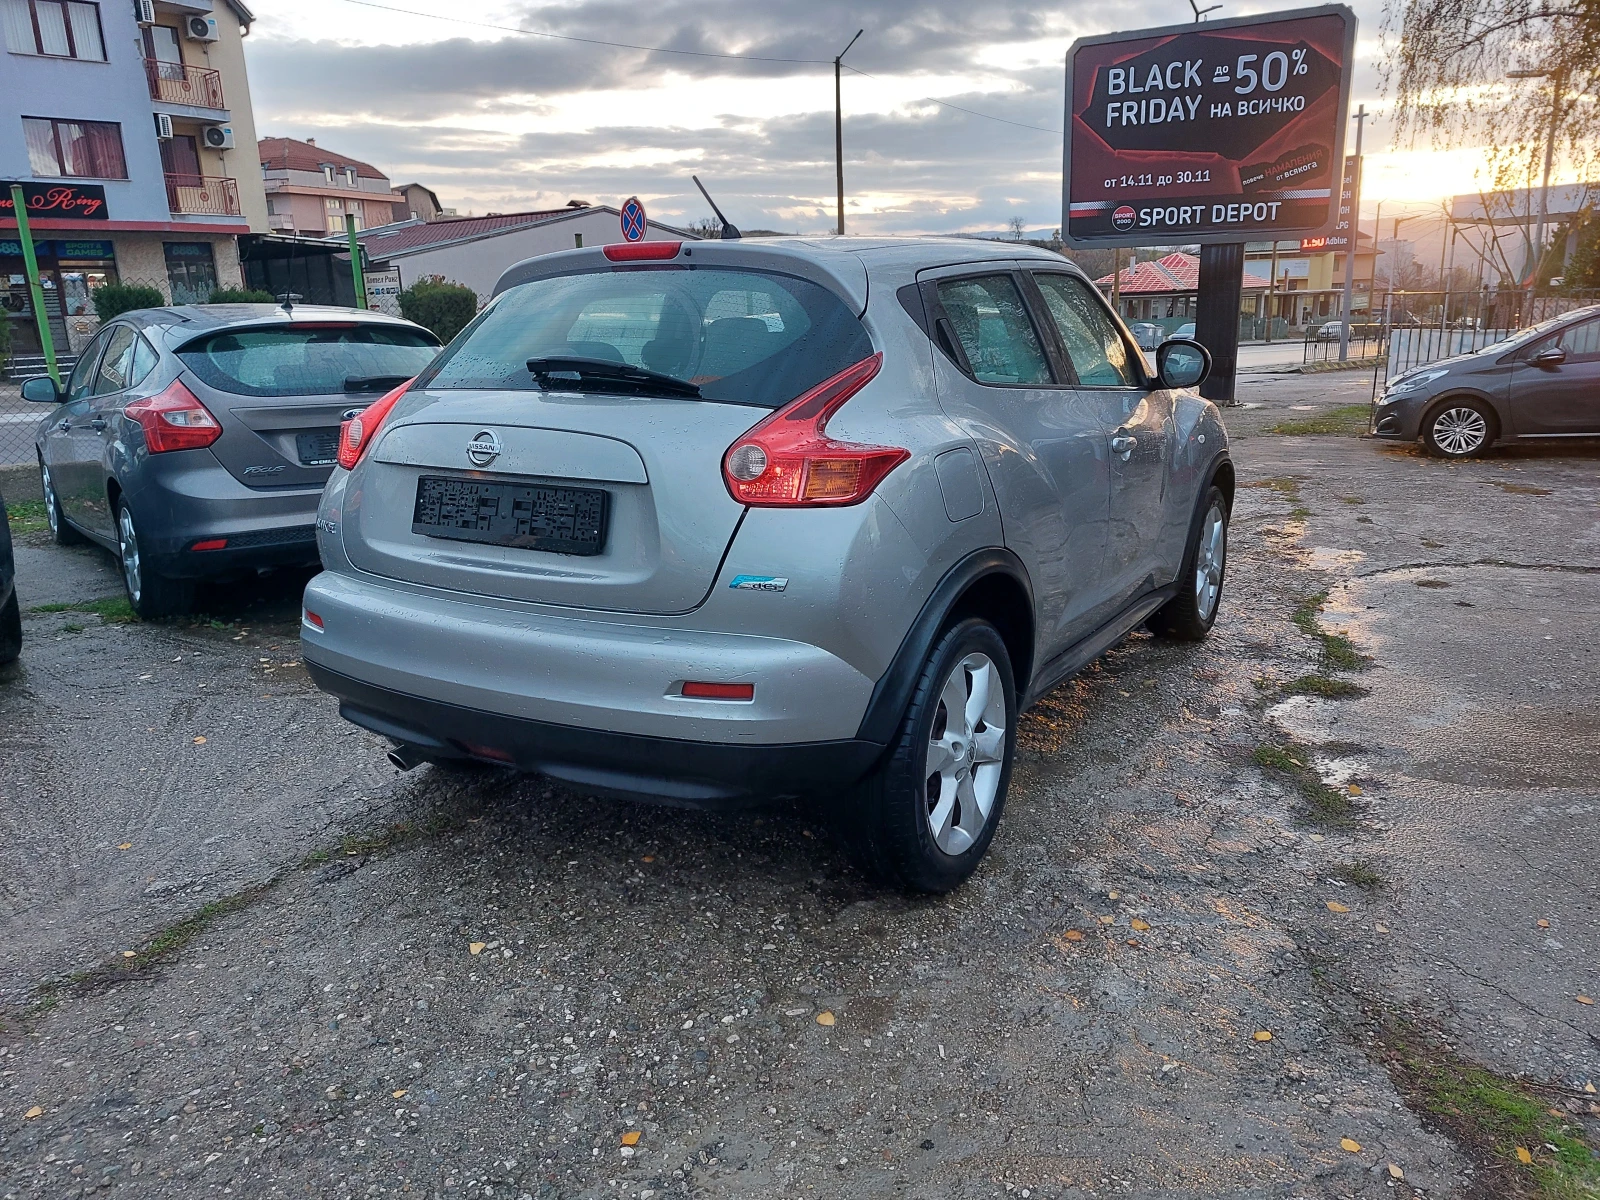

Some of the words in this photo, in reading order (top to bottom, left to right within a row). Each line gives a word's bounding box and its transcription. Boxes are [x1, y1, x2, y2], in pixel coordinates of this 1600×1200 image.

[1108, 59, 1203, 95] BLACK
[1106, 94, 1203, 128] FRIDAY
[1210, 102, 1232, 118] НА
[1237, 95, 1306, 117] ВСИЧКО
[1264, 149, 1323, 177] НАМАЛЕНИЯ
[1104, 178, 1117, 188] от
[1120, 173, 1153, 187] 14.11
[1156, 175, 1173, 188] до
[1176, 169, 1211, 184] 30.11
[1343, 175, 1352, 183] sel
[26, 187, 102, 215] Ring
[1139, 205, 1206, 227] SPORT
[1212, 201, 1282, 224] DEPOT
[1325, 236, 1348, 245] Adblue
